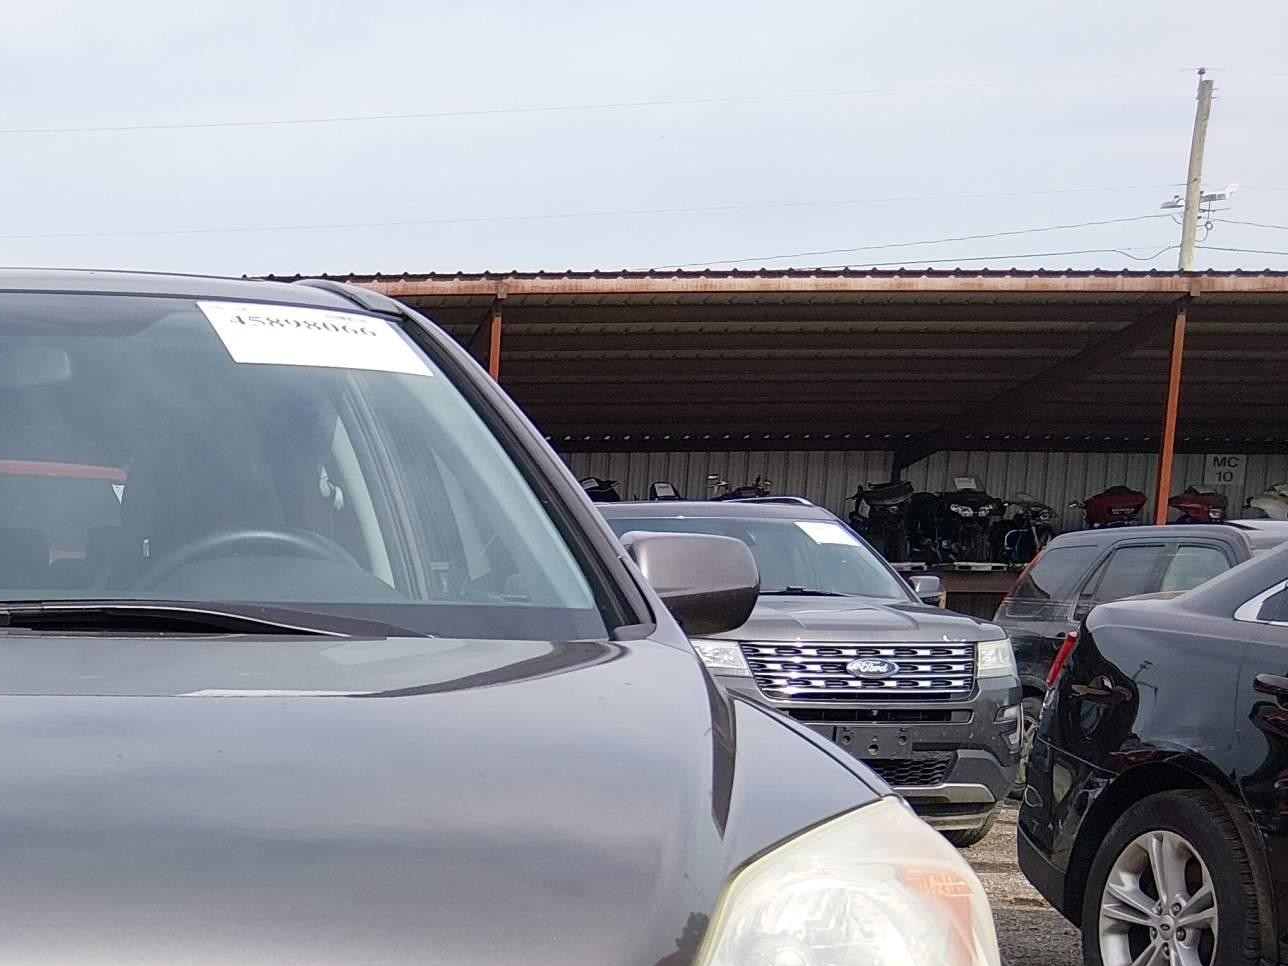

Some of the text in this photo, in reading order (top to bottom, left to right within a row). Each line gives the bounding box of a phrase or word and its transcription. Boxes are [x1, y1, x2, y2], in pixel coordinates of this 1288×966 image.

[1213, 456, 1240, 468] MC
[1216, 471, 1233, 482] 10
[859, 661, 889, 673] Ford
